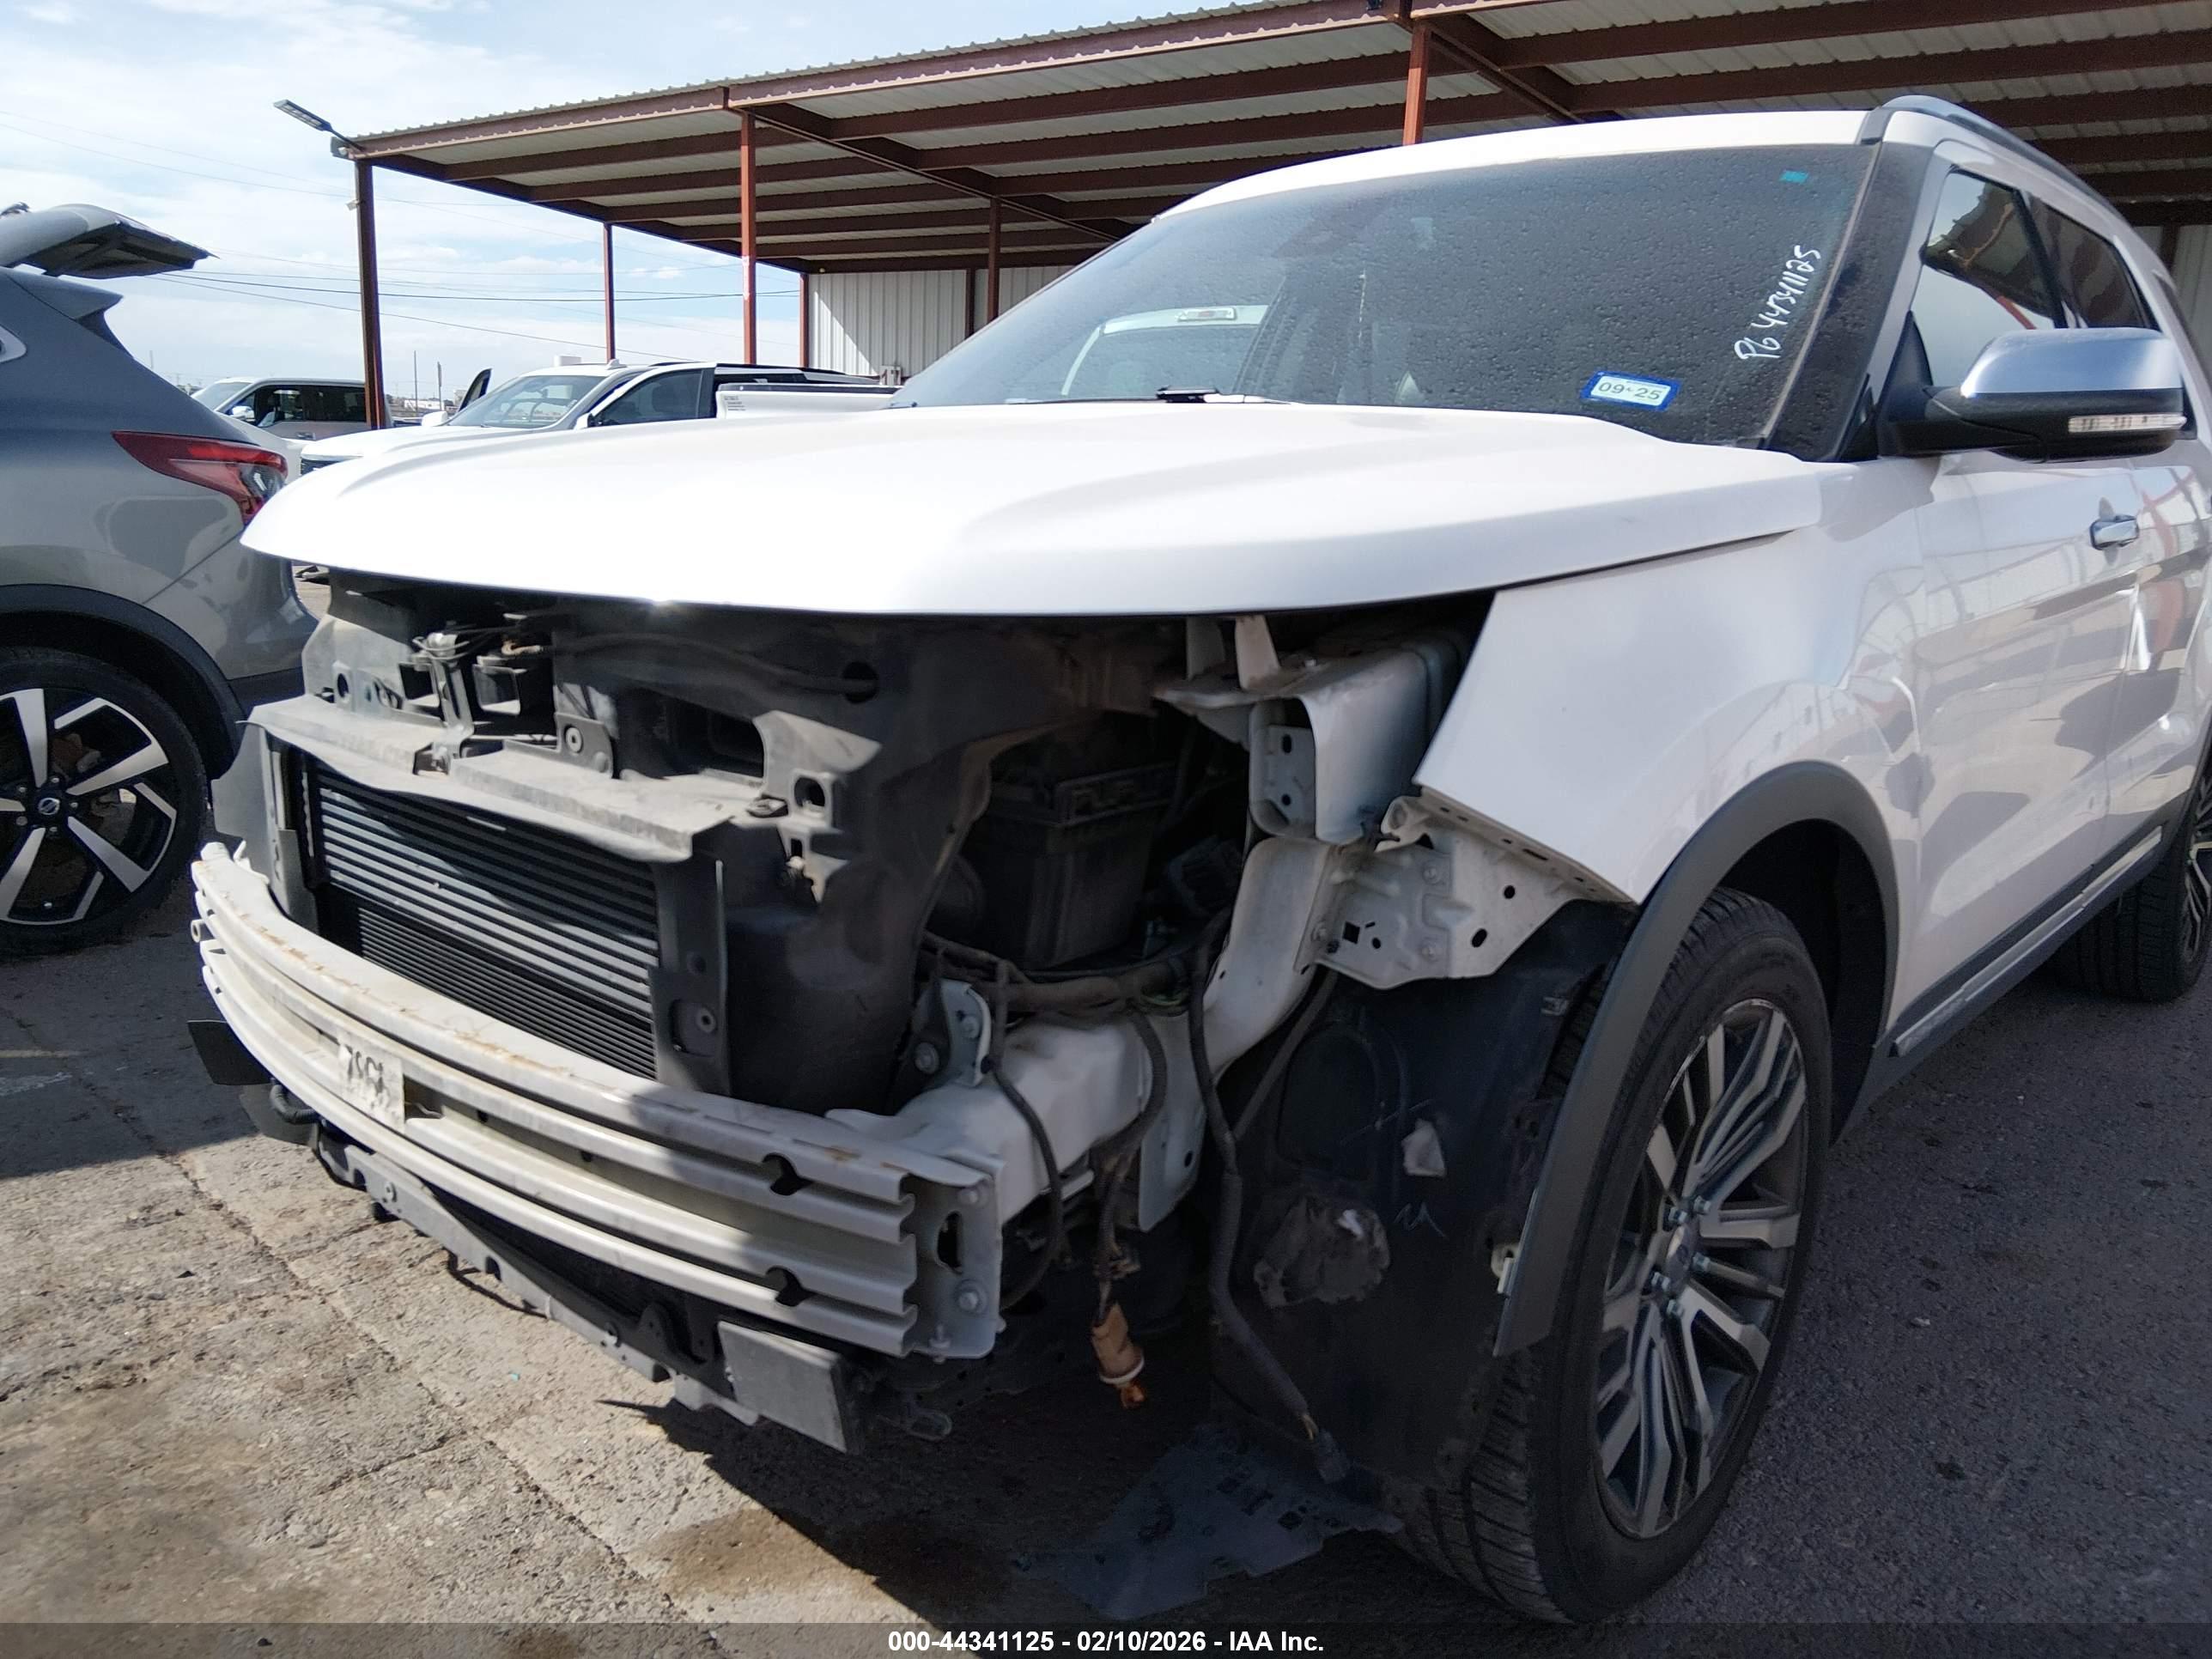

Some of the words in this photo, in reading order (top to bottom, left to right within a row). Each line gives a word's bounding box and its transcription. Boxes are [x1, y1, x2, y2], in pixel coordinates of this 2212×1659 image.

[1751, 245, 1821, 329] 44341125
[1598, 381, 1626, 395] 09
[1634, 386, 1662, 401] 25
